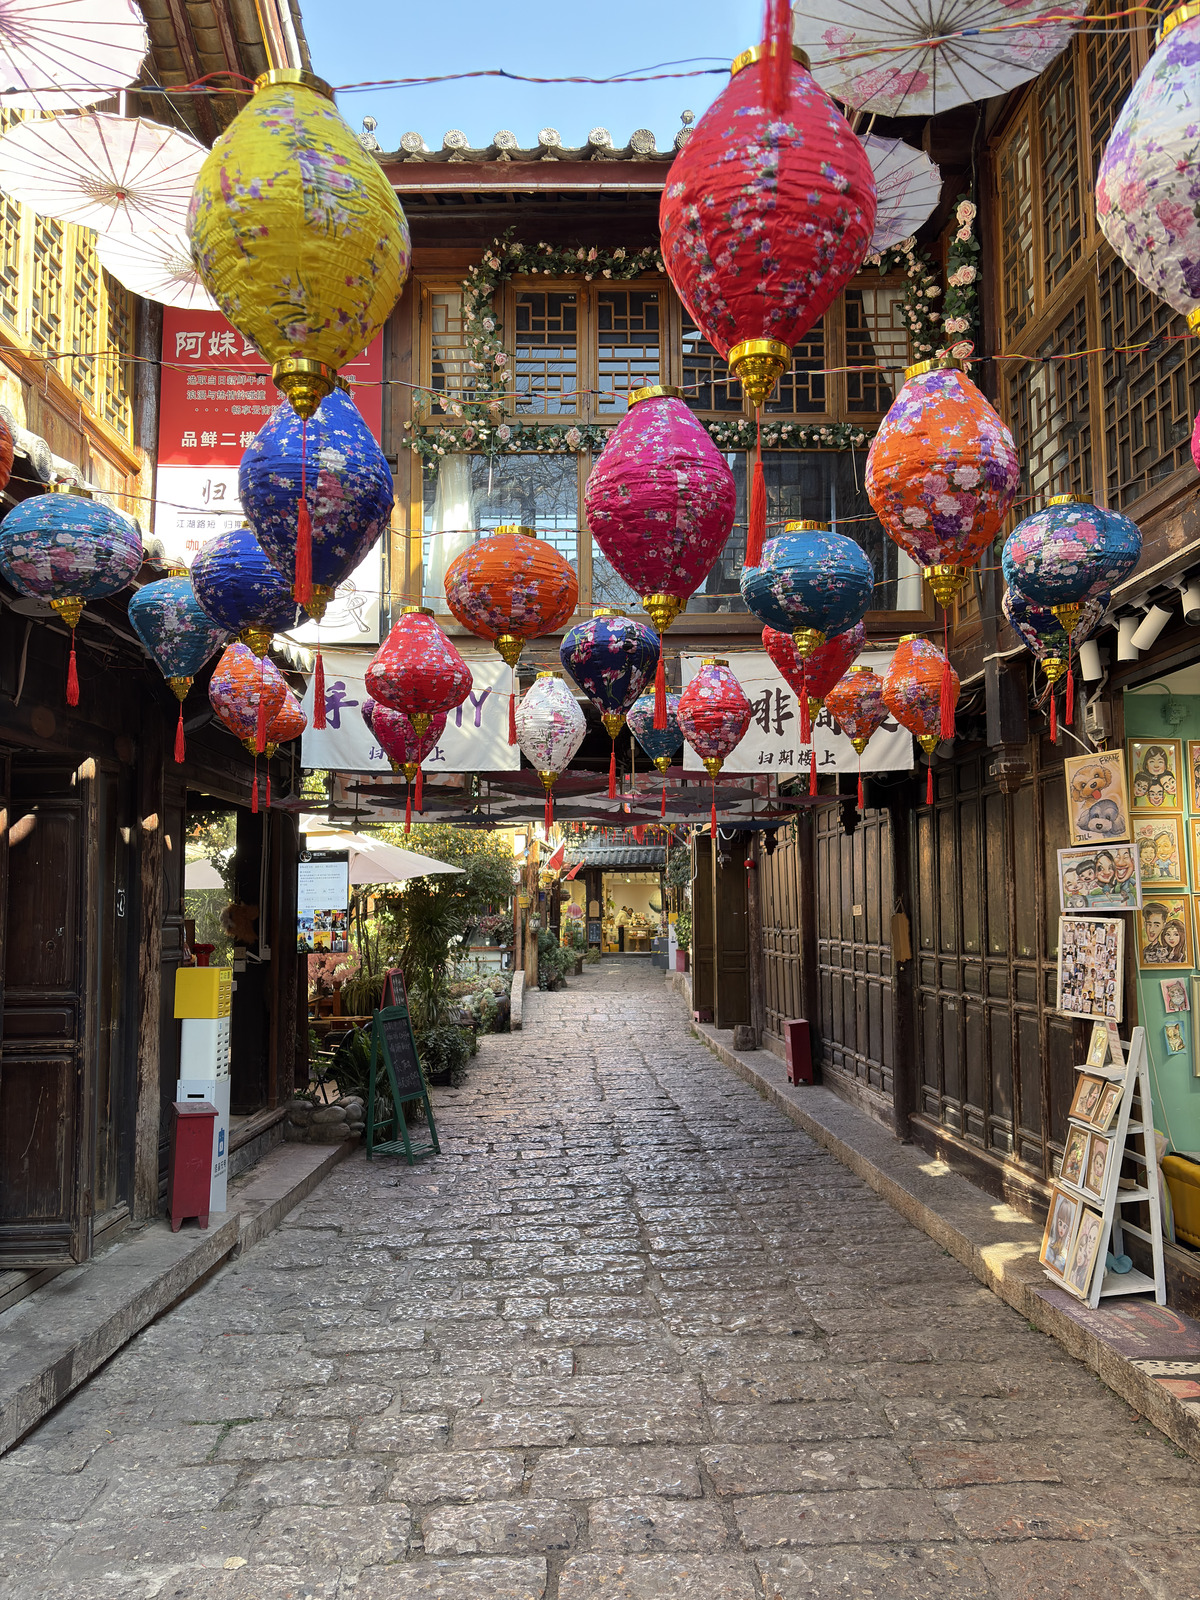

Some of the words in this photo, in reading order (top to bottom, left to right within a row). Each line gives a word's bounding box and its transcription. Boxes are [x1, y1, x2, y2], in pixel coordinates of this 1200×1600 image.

[186, 389, 267, 401] 浪漫与热情的碰撞
